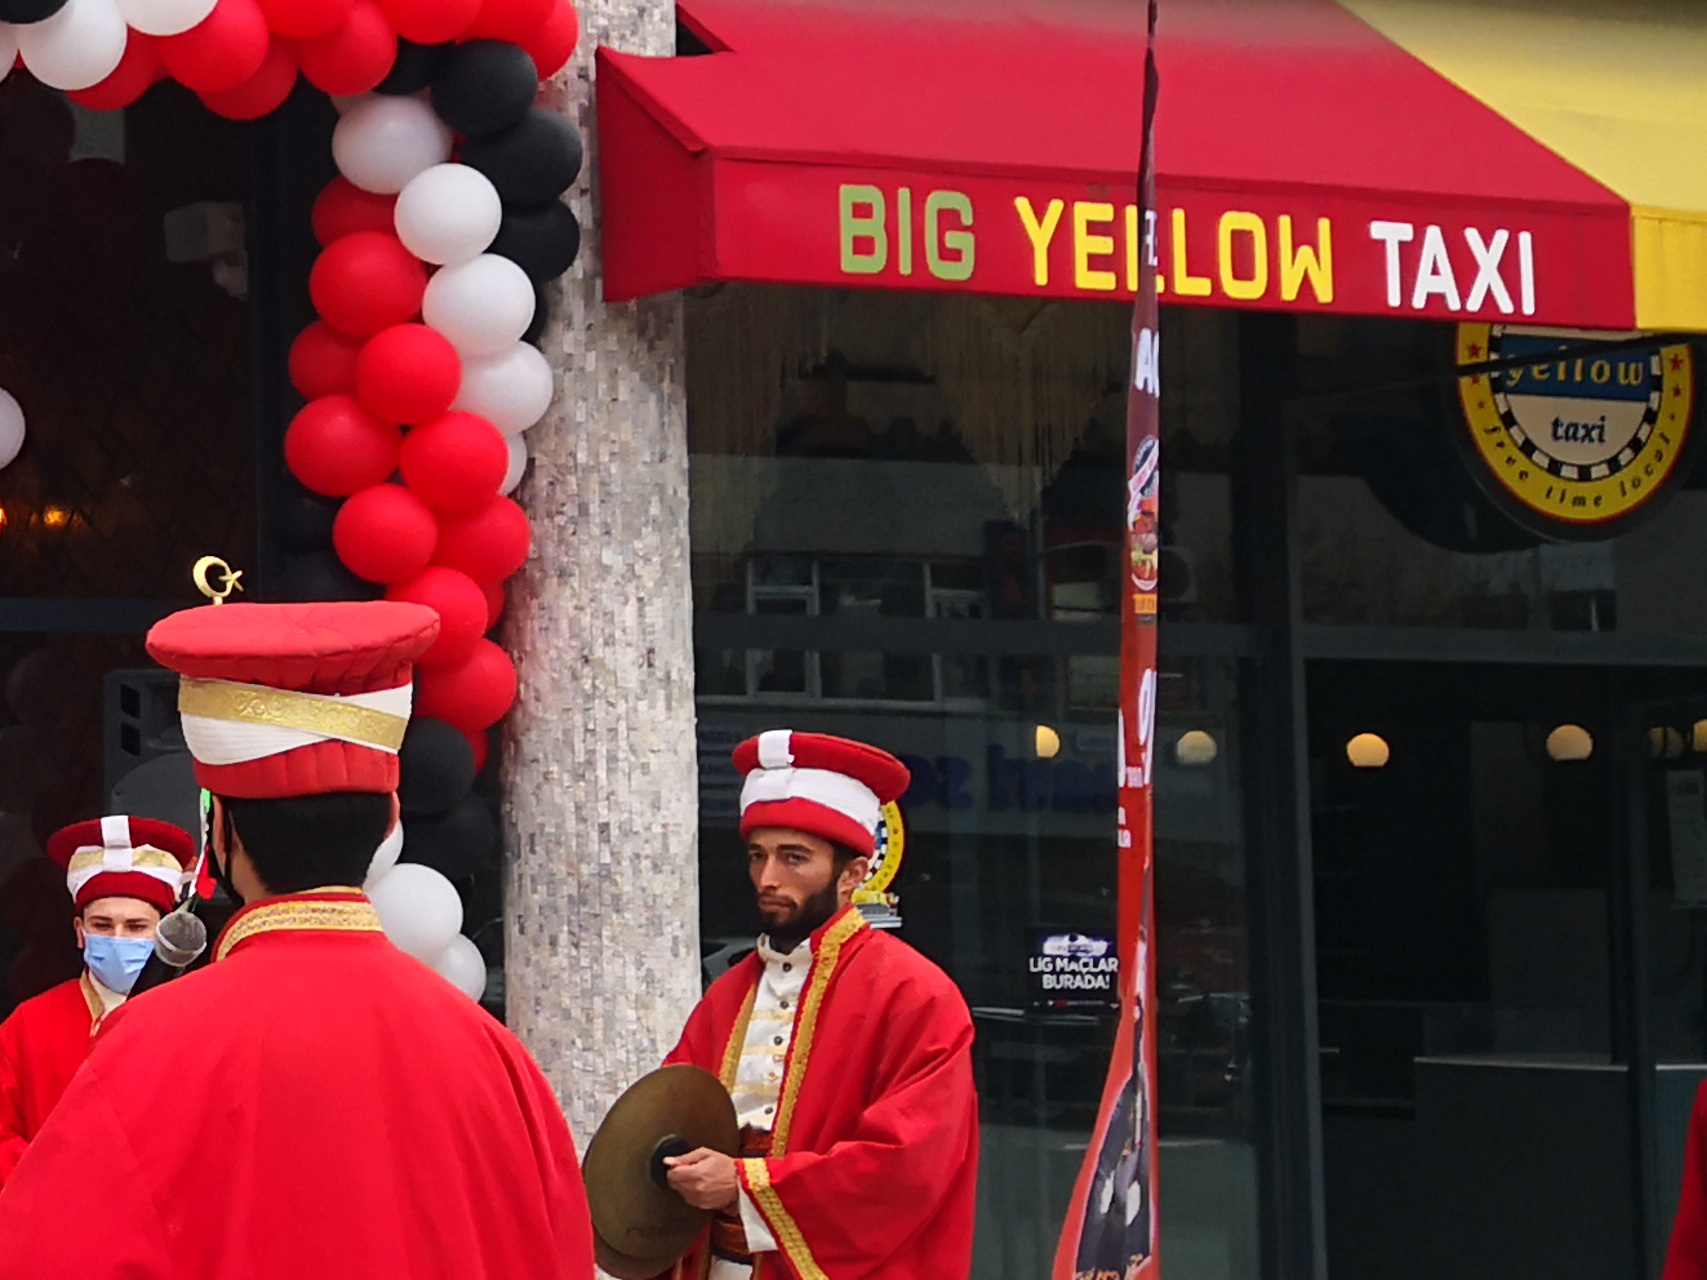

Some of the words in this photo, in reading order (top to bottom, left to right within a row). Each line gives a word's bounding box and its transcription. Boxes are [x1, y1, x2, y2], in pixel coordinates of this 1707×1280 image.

[838, 184, 975, 280] BIG
[1015, 196, 1333, 303] YELLOW
[1370, 221, 1535, 315] TAXI
[1552, 415, 1607, 443] taxi
[1042, 973, 1110, 990] BURADA!
